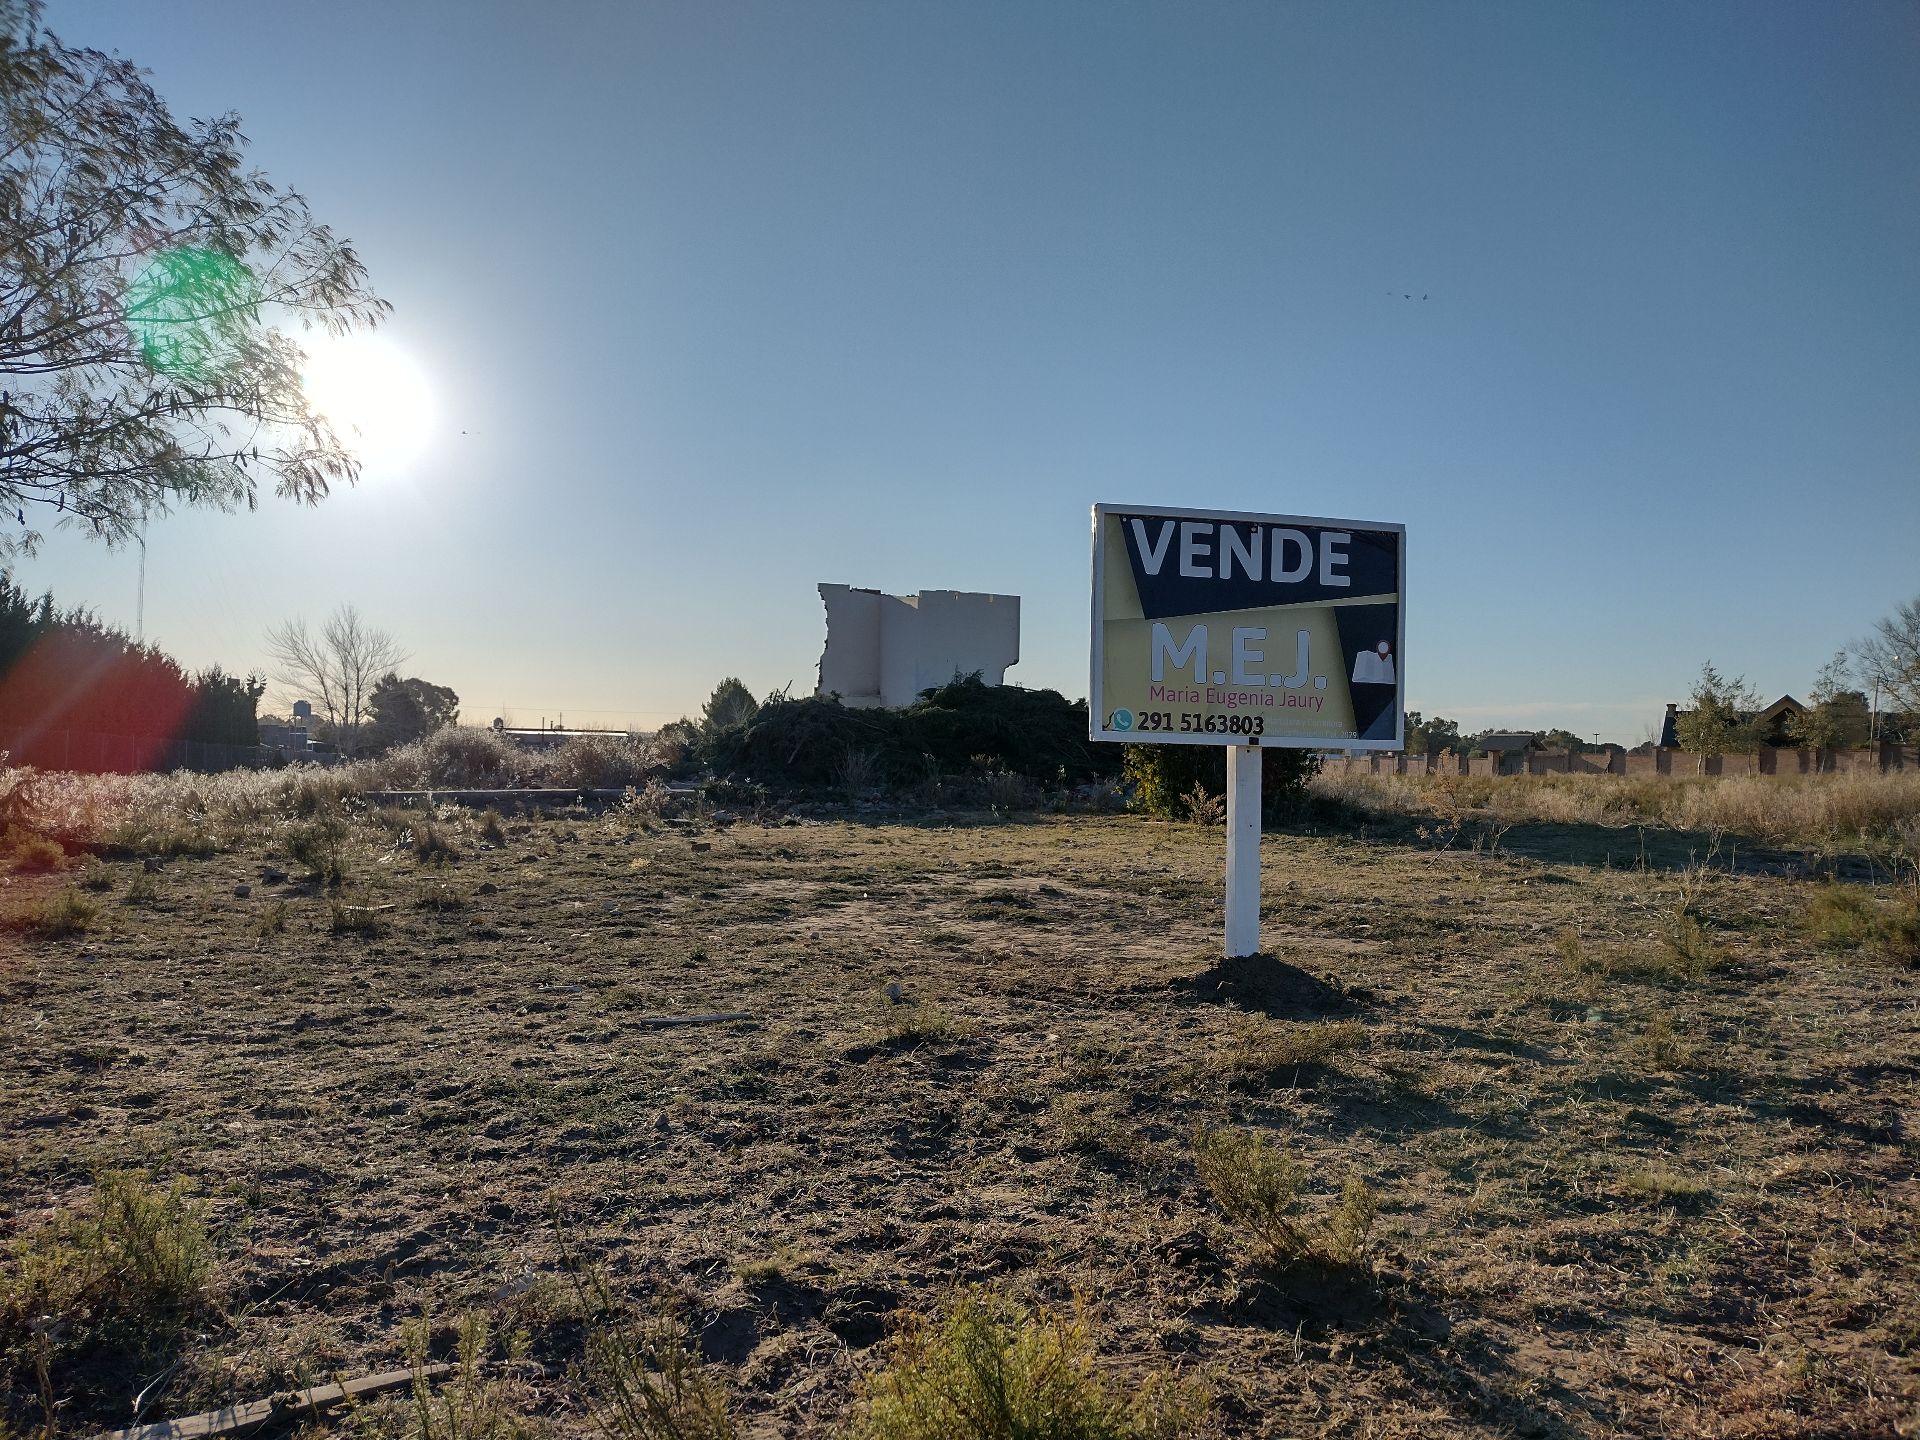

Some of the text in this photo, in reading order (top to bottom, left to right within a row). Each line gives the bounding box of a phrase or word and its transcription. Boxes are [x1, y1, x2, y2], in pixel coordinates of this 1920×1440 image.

[1130, 518, 1351, 587] VENDE
[1150, 623, 1328, 690] M.E.J.
[1206, 688, 1274, 709] Eugenia
[1279, 692, 1324, 712] Jaury
[1138, 711, 1173, 731] 291
[1180, 712, 1264, 735] 5163803
